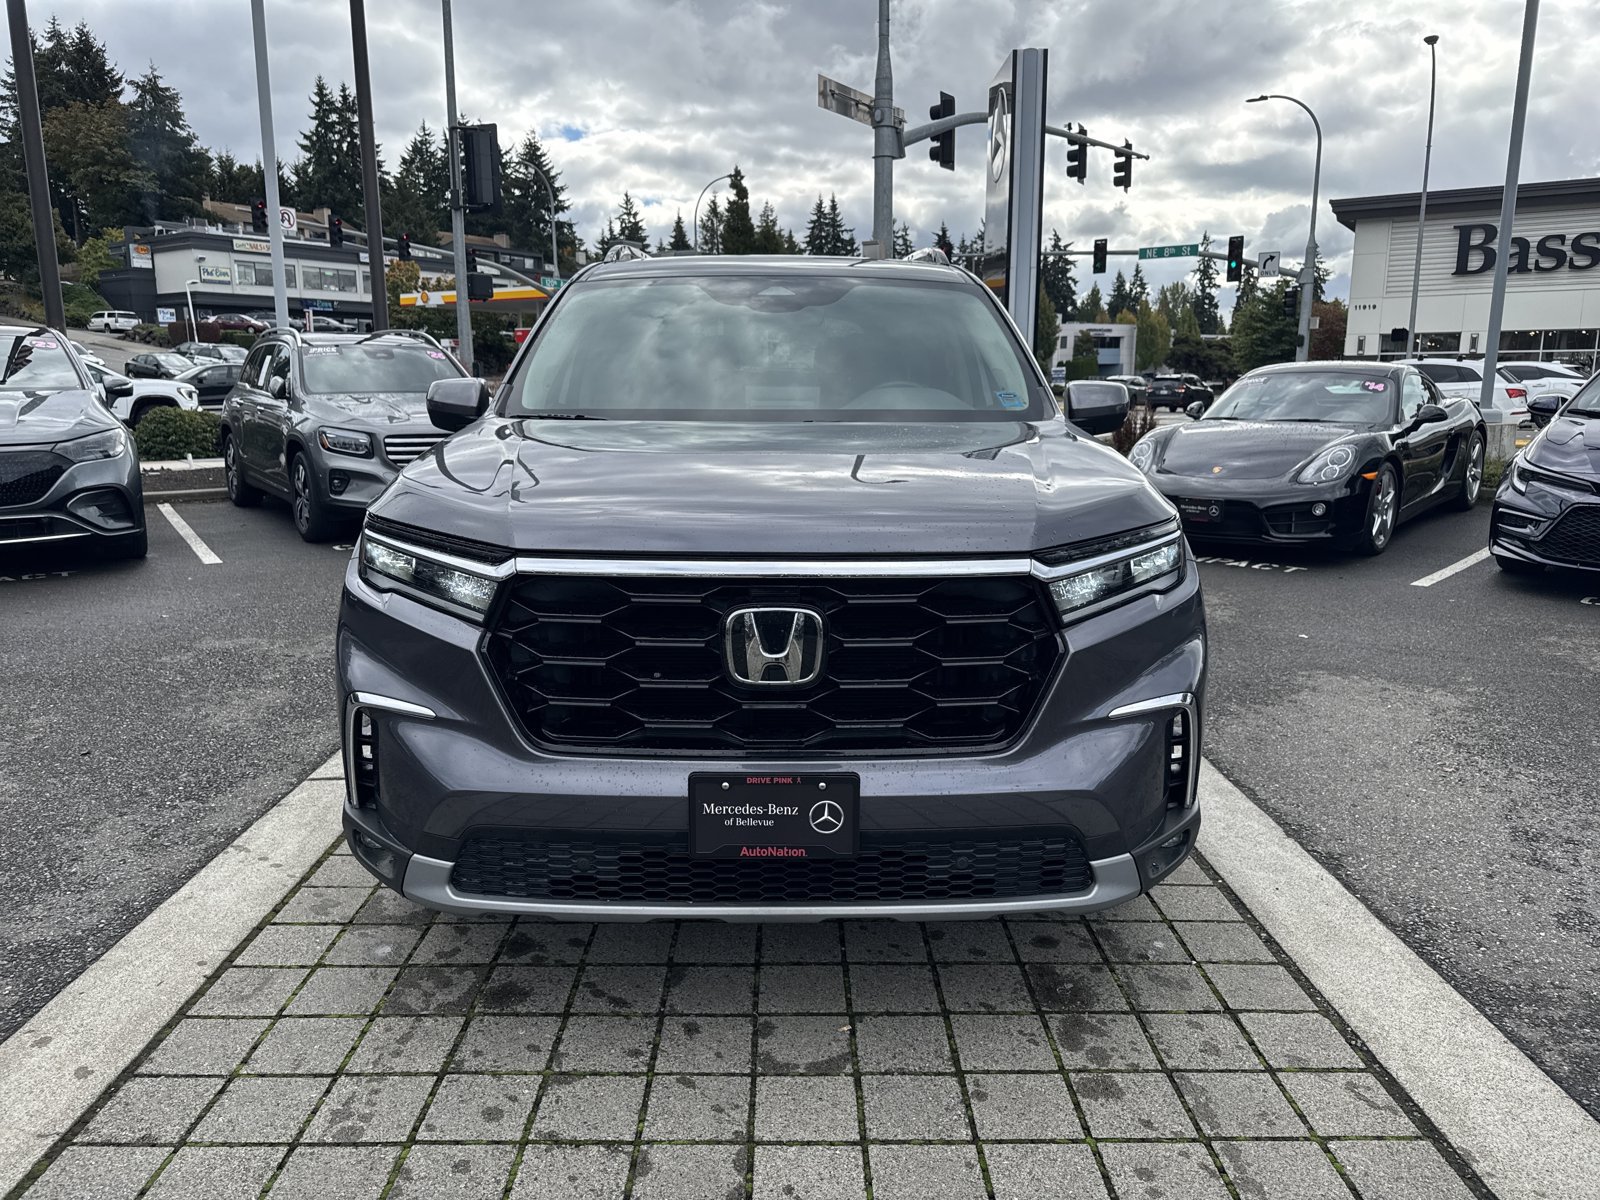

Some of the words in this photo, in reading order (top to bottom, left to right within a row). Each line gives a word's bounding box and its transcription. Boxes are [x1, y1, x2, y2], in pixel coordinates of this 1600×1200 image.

[1146, 248, 1158, 258] NE
[1163, 247, 1176, 257] 8th
[1181, 246, 1191, 256] St
[702, 803, 799, 815] Mercedes-Benz
[724, 817, 734, 826] of
[736, 817, 774, 827] Bellevue
[740, 846, 806, 857] AutoNation
